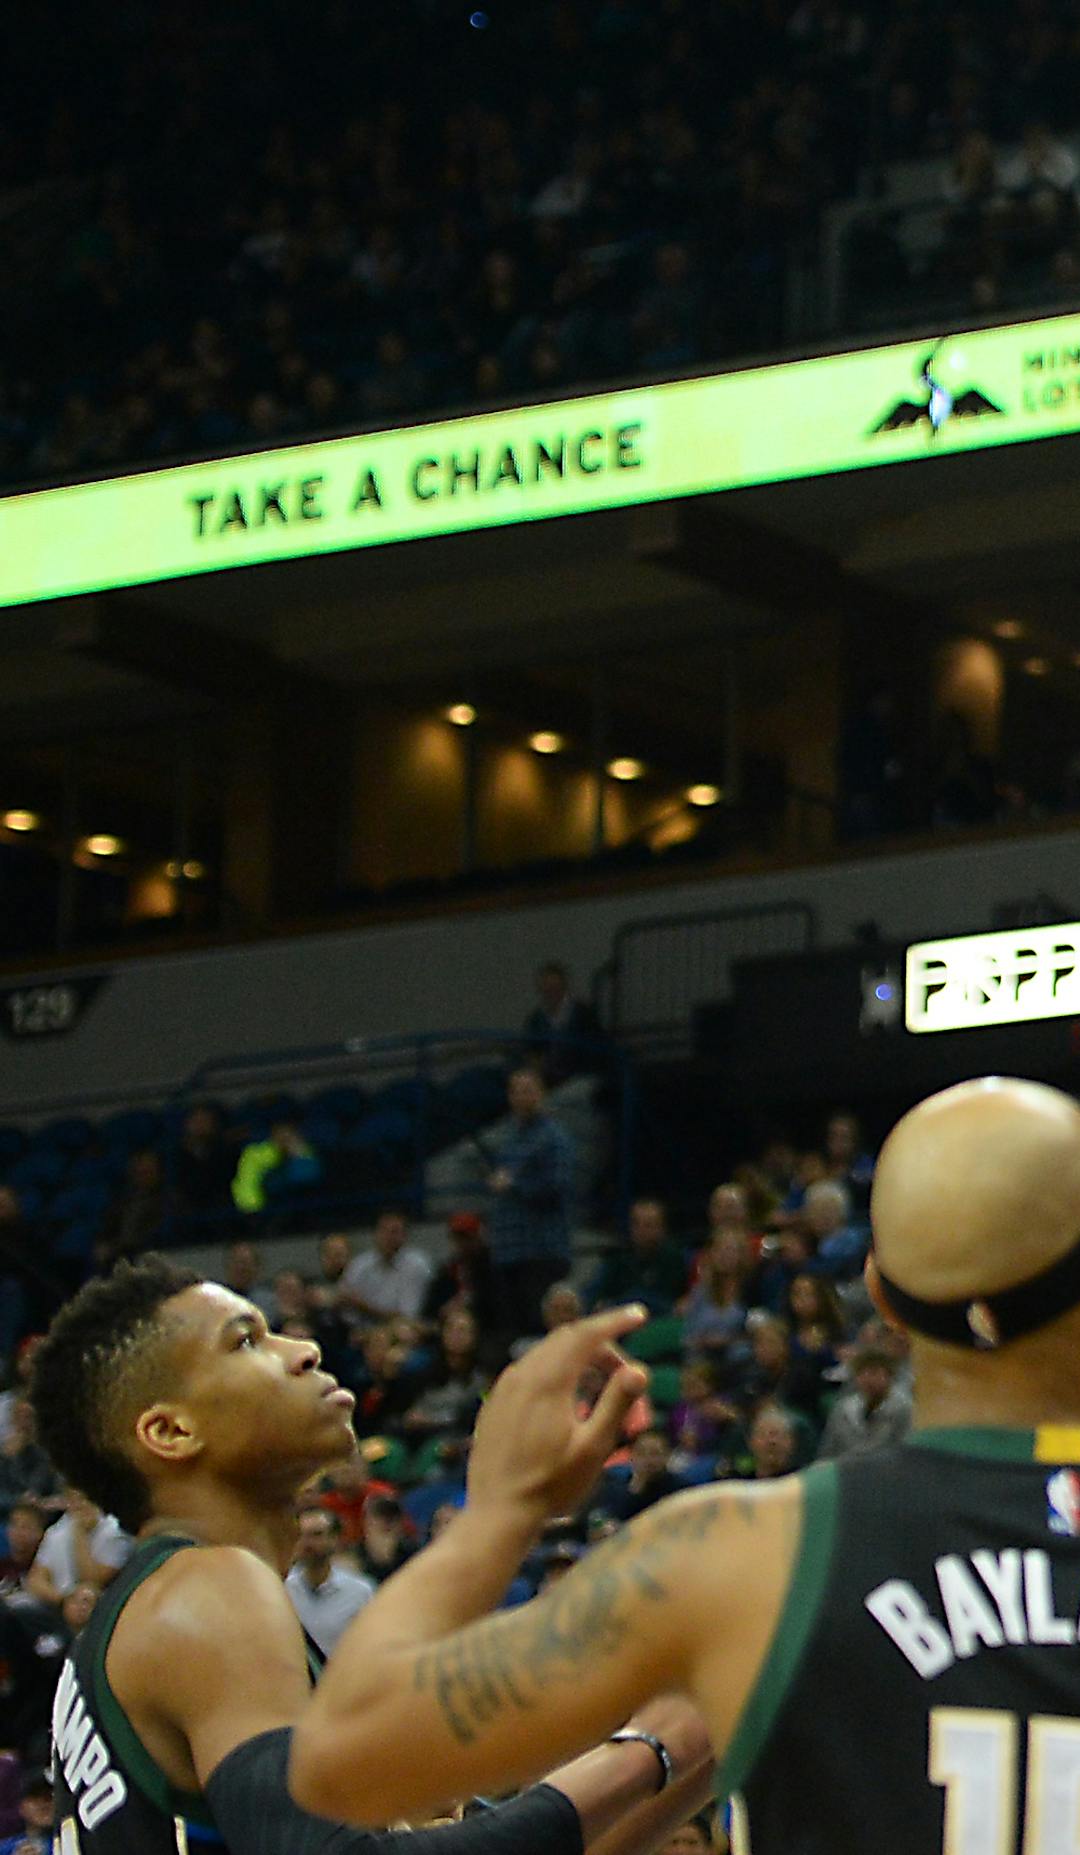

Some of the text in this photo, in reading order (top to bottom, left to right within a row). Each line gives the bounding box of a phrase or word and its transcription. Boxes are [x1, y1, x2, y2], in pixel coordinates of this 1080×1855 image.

[187, 421, 644, 539] TAKE A CHANCE
